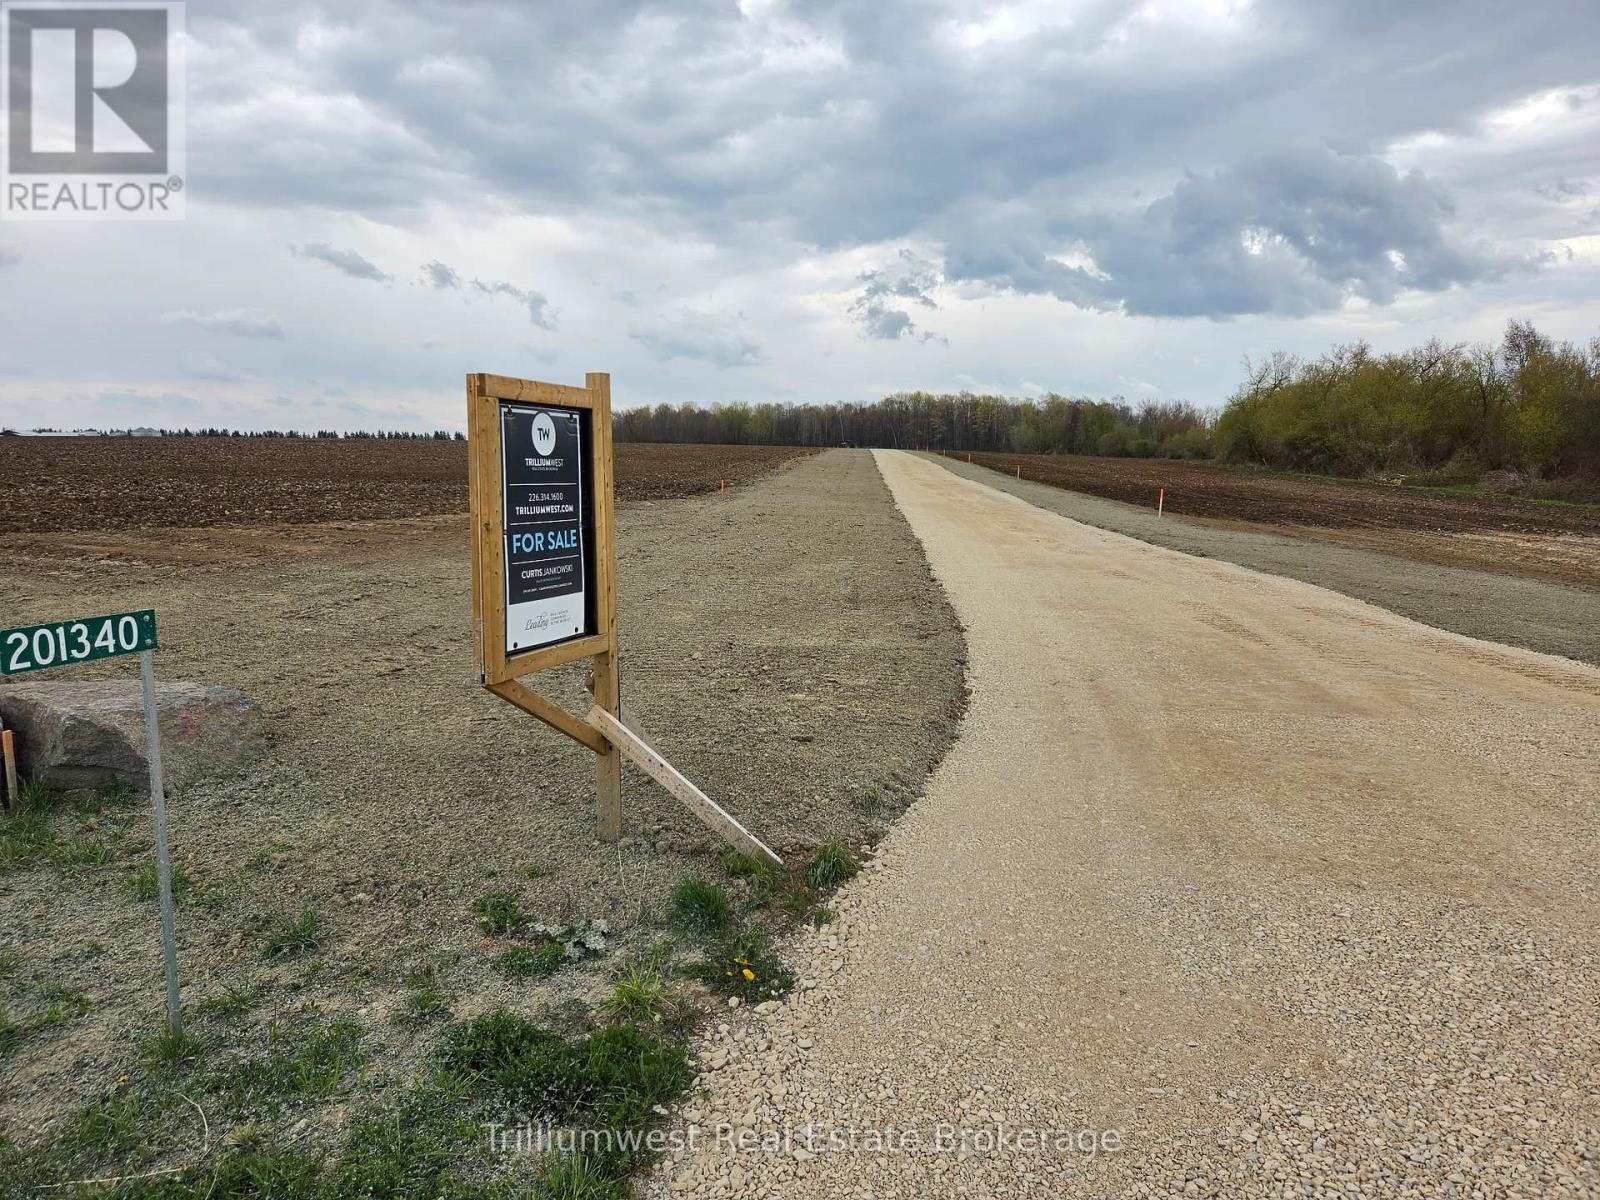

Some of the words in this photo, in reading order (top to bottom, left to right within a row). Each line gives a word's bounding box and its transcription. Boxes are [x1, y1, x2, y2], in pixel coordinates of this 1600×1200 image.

[537, 428, 550, 441] TW
[528, 492, 564, 502] 226.314.1600
[515, 504, 574, 515] TRILLIUMWEST.COM
[512, 532, 545, 554] FOR
[548, 529, 577, 550] SALE
[6, 616, 139, 671] 201340
